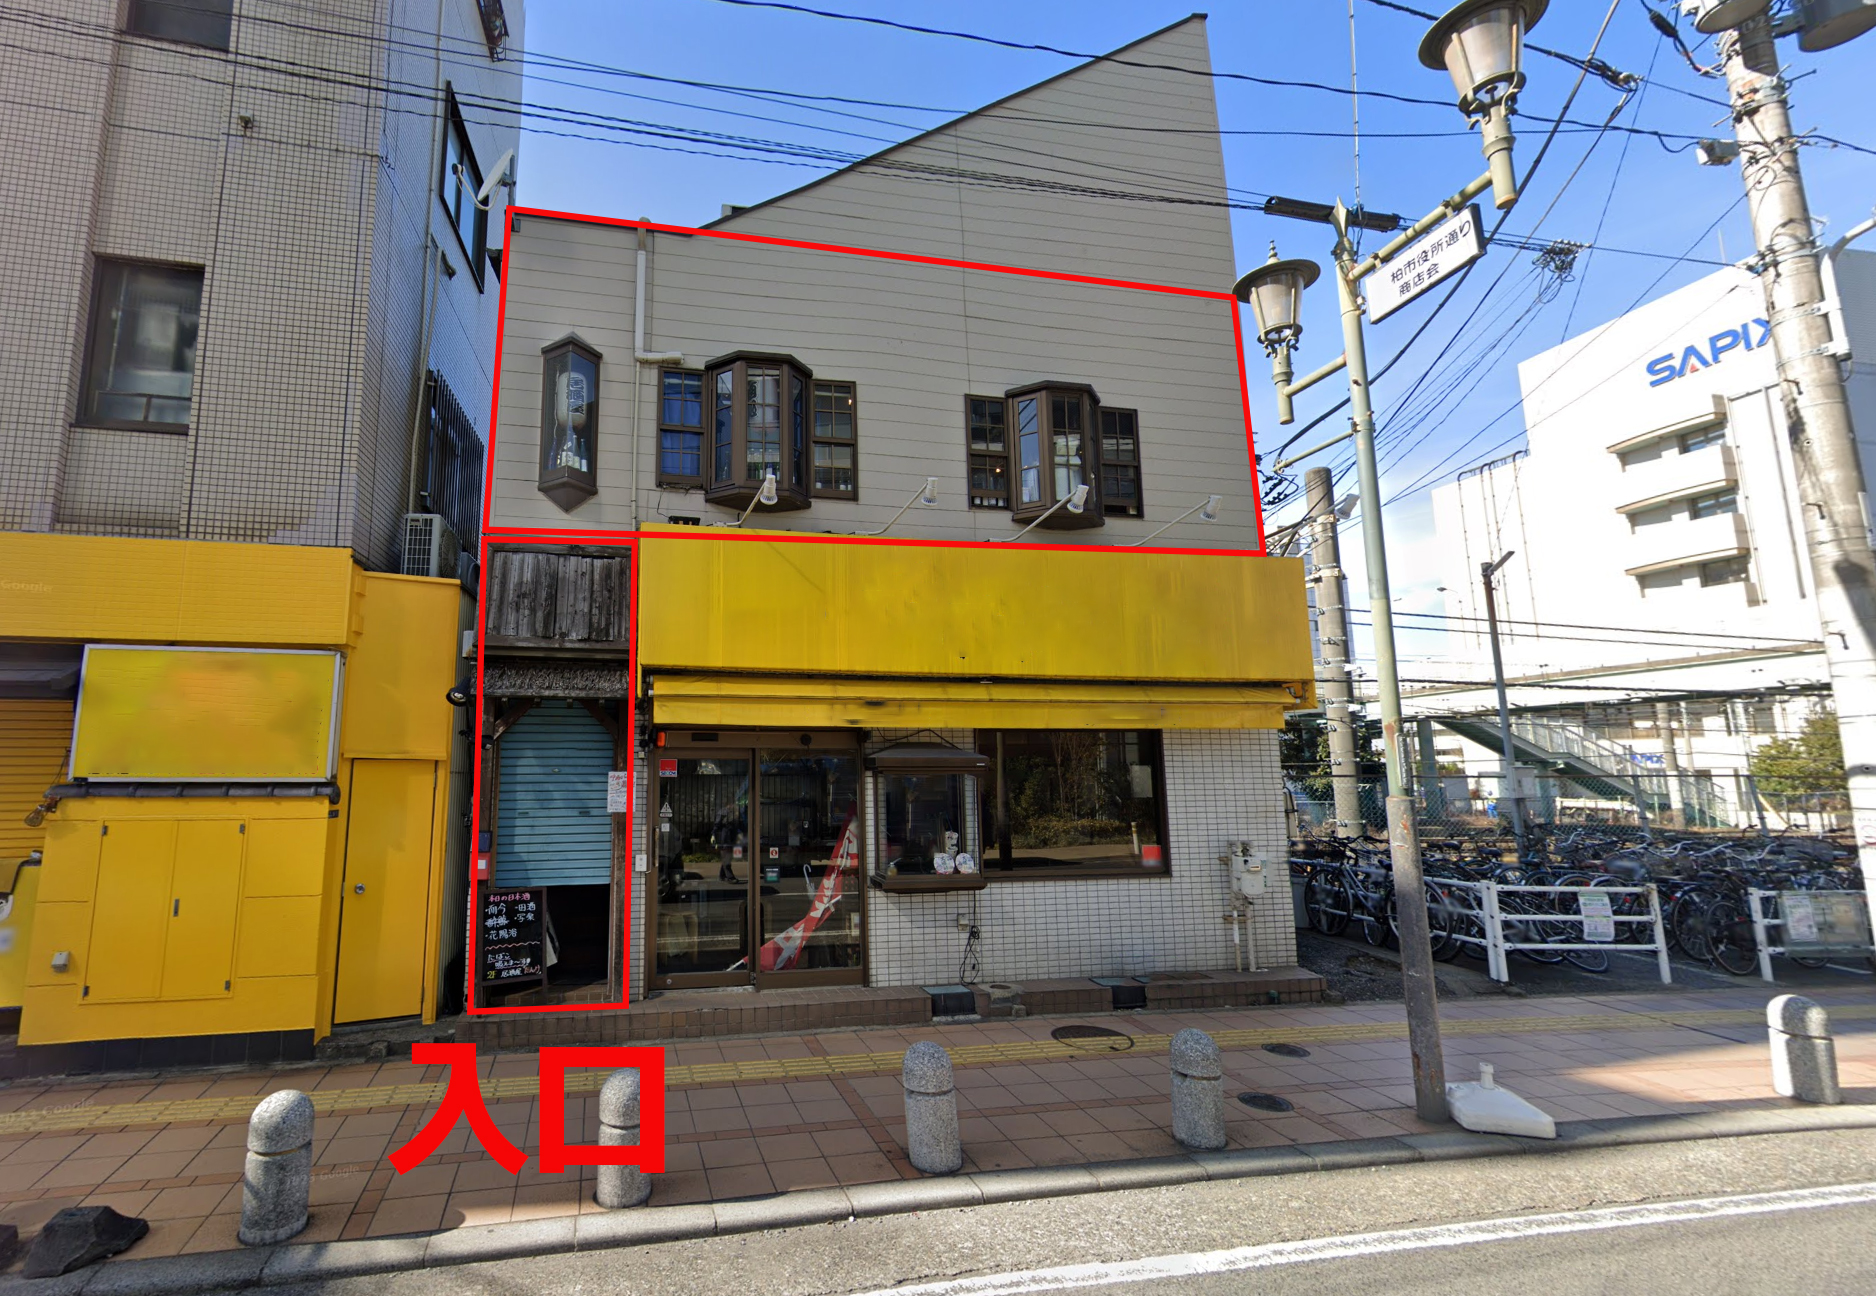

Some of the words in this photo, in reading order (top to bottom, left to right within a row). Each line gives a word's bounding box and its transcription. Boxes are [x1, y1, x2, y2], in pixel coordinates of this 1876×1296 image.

[1391, 220, 1471, 283] 柏市役所通り
[1399, 263, 1440, 296] 商店会
[489, 893, 530, 902] 本日の日本酒
